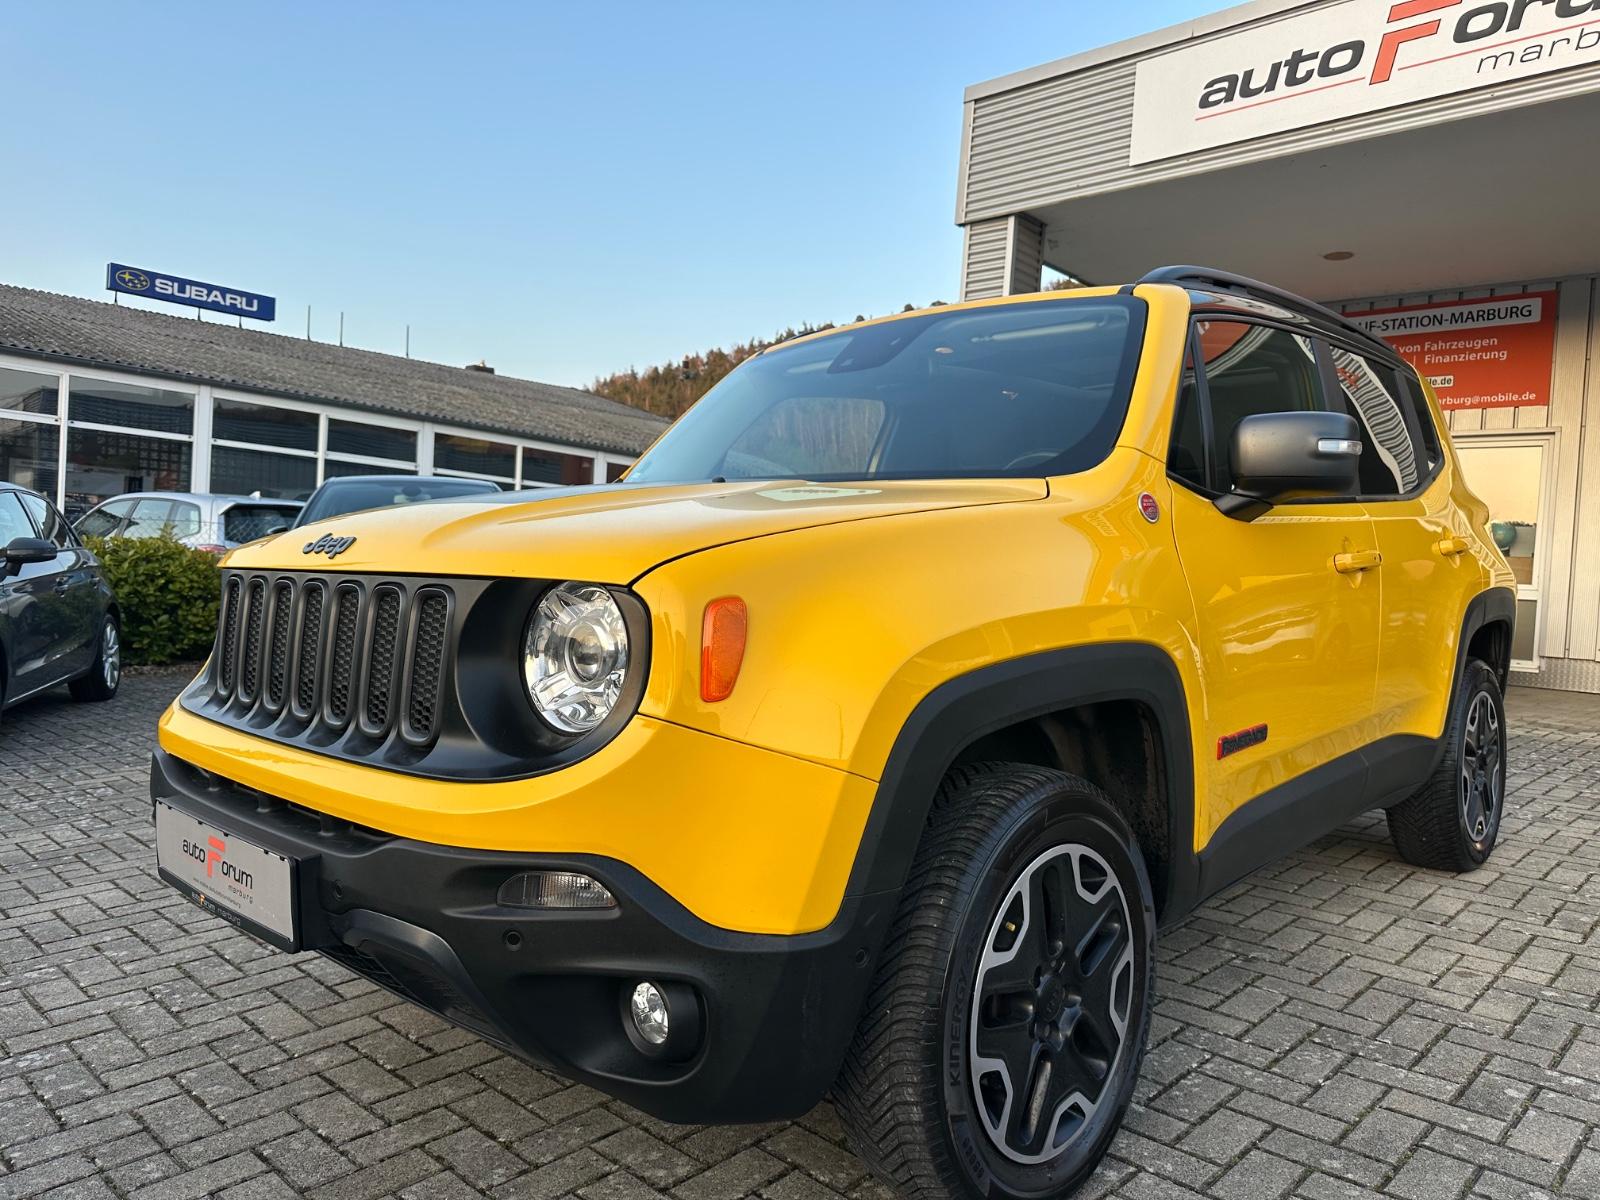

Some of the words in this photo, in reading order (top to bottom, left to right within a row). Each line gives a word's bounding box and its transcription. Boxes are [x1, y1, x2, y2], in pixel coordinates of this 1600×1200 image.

[154, 278, 258, 312] SUBARU
[1399, 344, 1421, 353] von
[1424, 336, 1498, 351] Fahrzeugen
[1424, 350, 1508, 364] Finanzierung
[303, 532, 357, 559] Jeep
